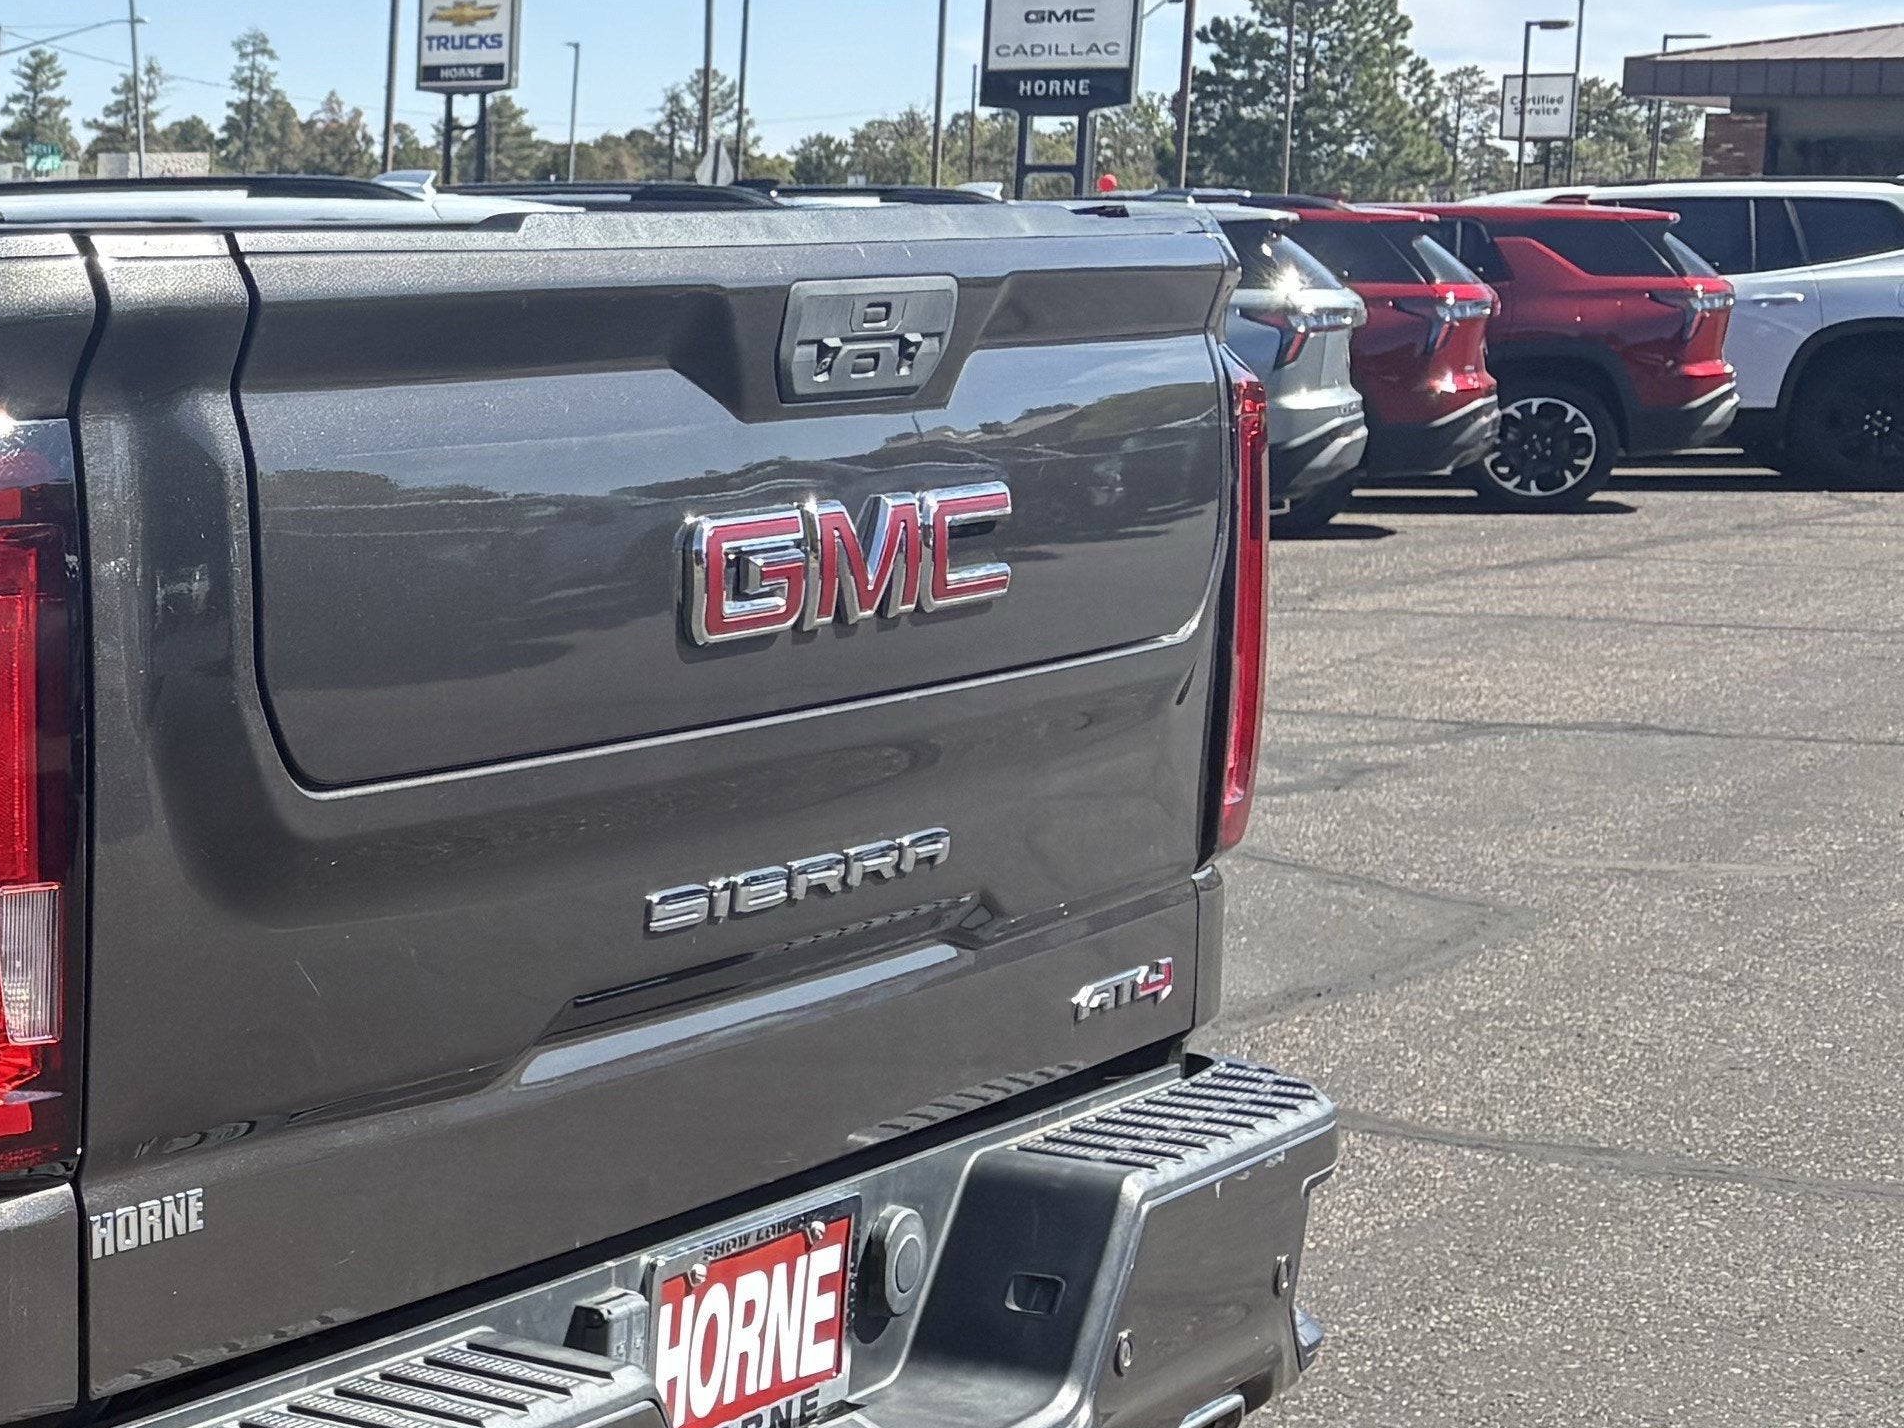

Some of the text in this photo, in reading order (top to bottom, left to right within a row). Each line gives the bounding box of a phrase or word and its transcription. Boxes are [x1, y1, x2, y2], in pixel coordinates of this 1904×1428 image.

[1024, 8, 1096, 24] GMC
[425, 34, 503, 51] TRUCKS
[995, 42, 1121, 58] CADILLAC
[1019, 79, 1091, 96] HORNE
[1510, 95, 1564, 105] Crtified
[1513, 107, 1560, 115] Srvice
[686, 481, 1012, 646] GMC
[646, 826, 951, 933] SIERRA
[1071, 957, 1173, 1022] AT4
[90, 1188, 204, 1260] HORNE
